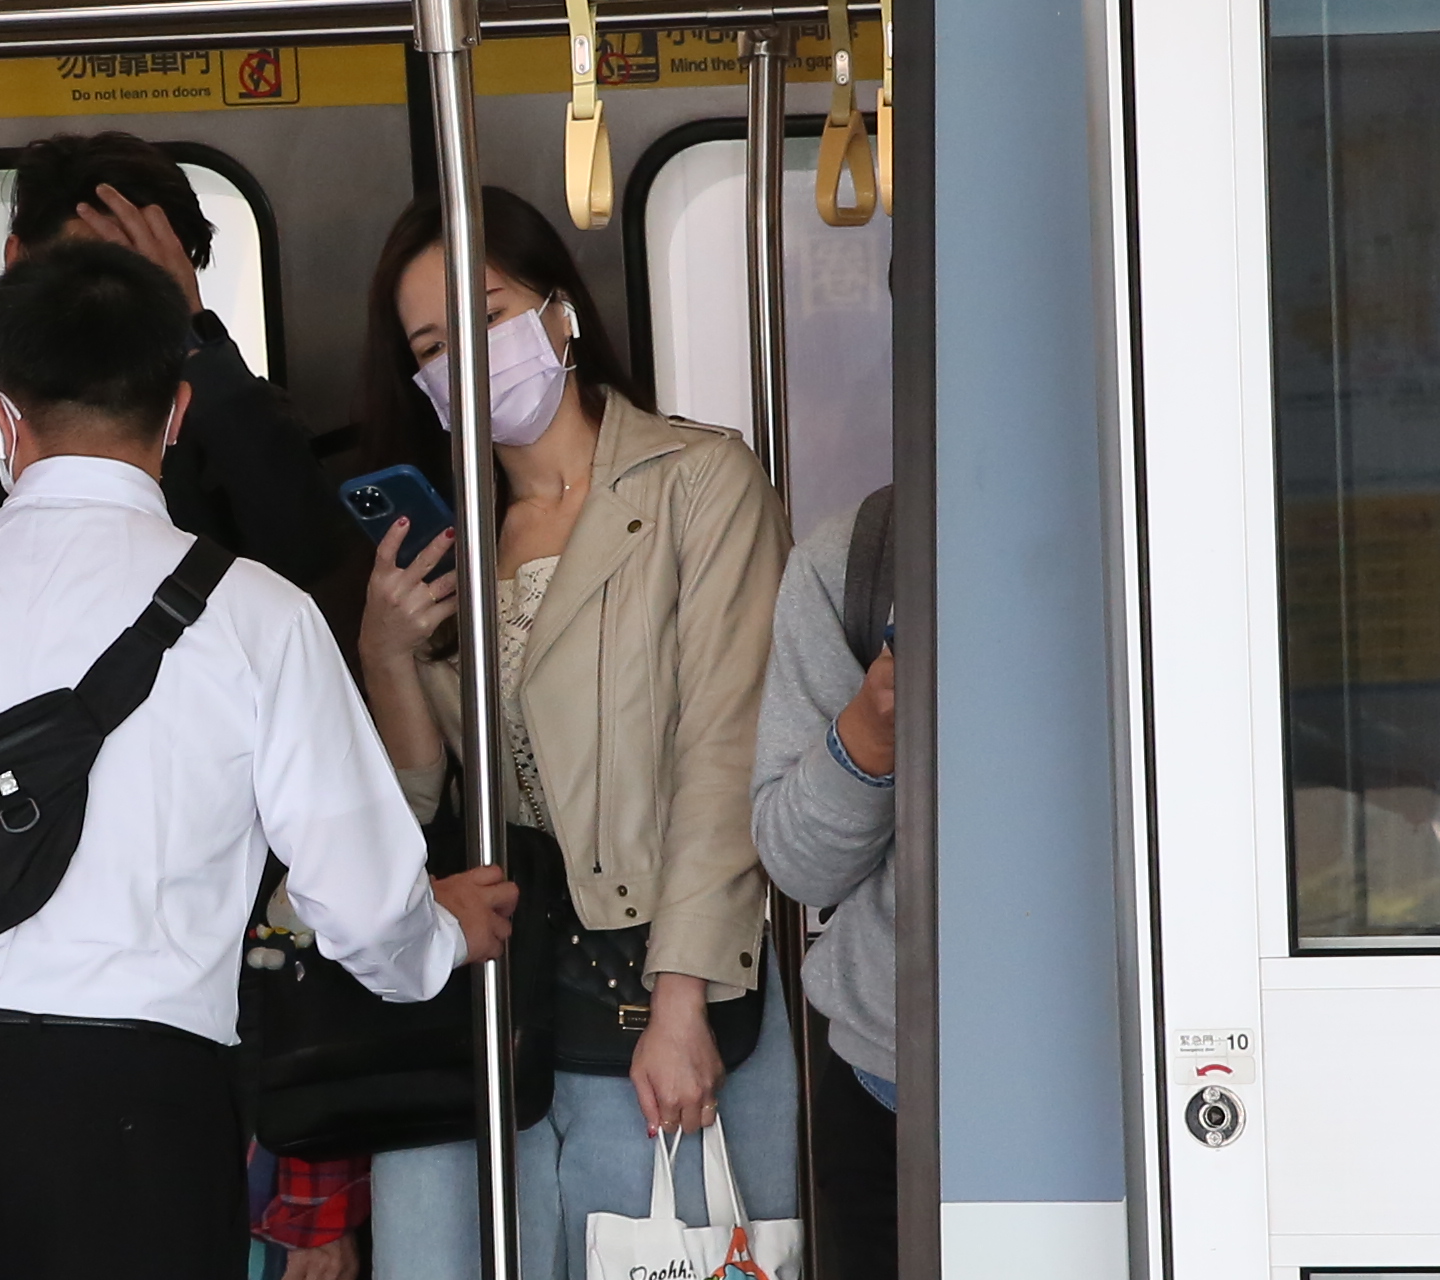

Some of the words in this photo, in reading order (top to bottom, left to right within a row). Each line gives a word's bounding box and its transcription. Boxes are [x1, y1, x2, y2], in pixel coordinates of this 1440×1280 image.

[672, 58, 707, 72] Mind
[711, 58, 735, 70] the
[72, 90, 90, 100] Do
[95, 90, 116, 100] not
[121, 89, 147, 99] lean
[152, 90, 169, 98] on
[173, 87, 210, 97] doors
[1227, 1034, 1248, 1050] 10
